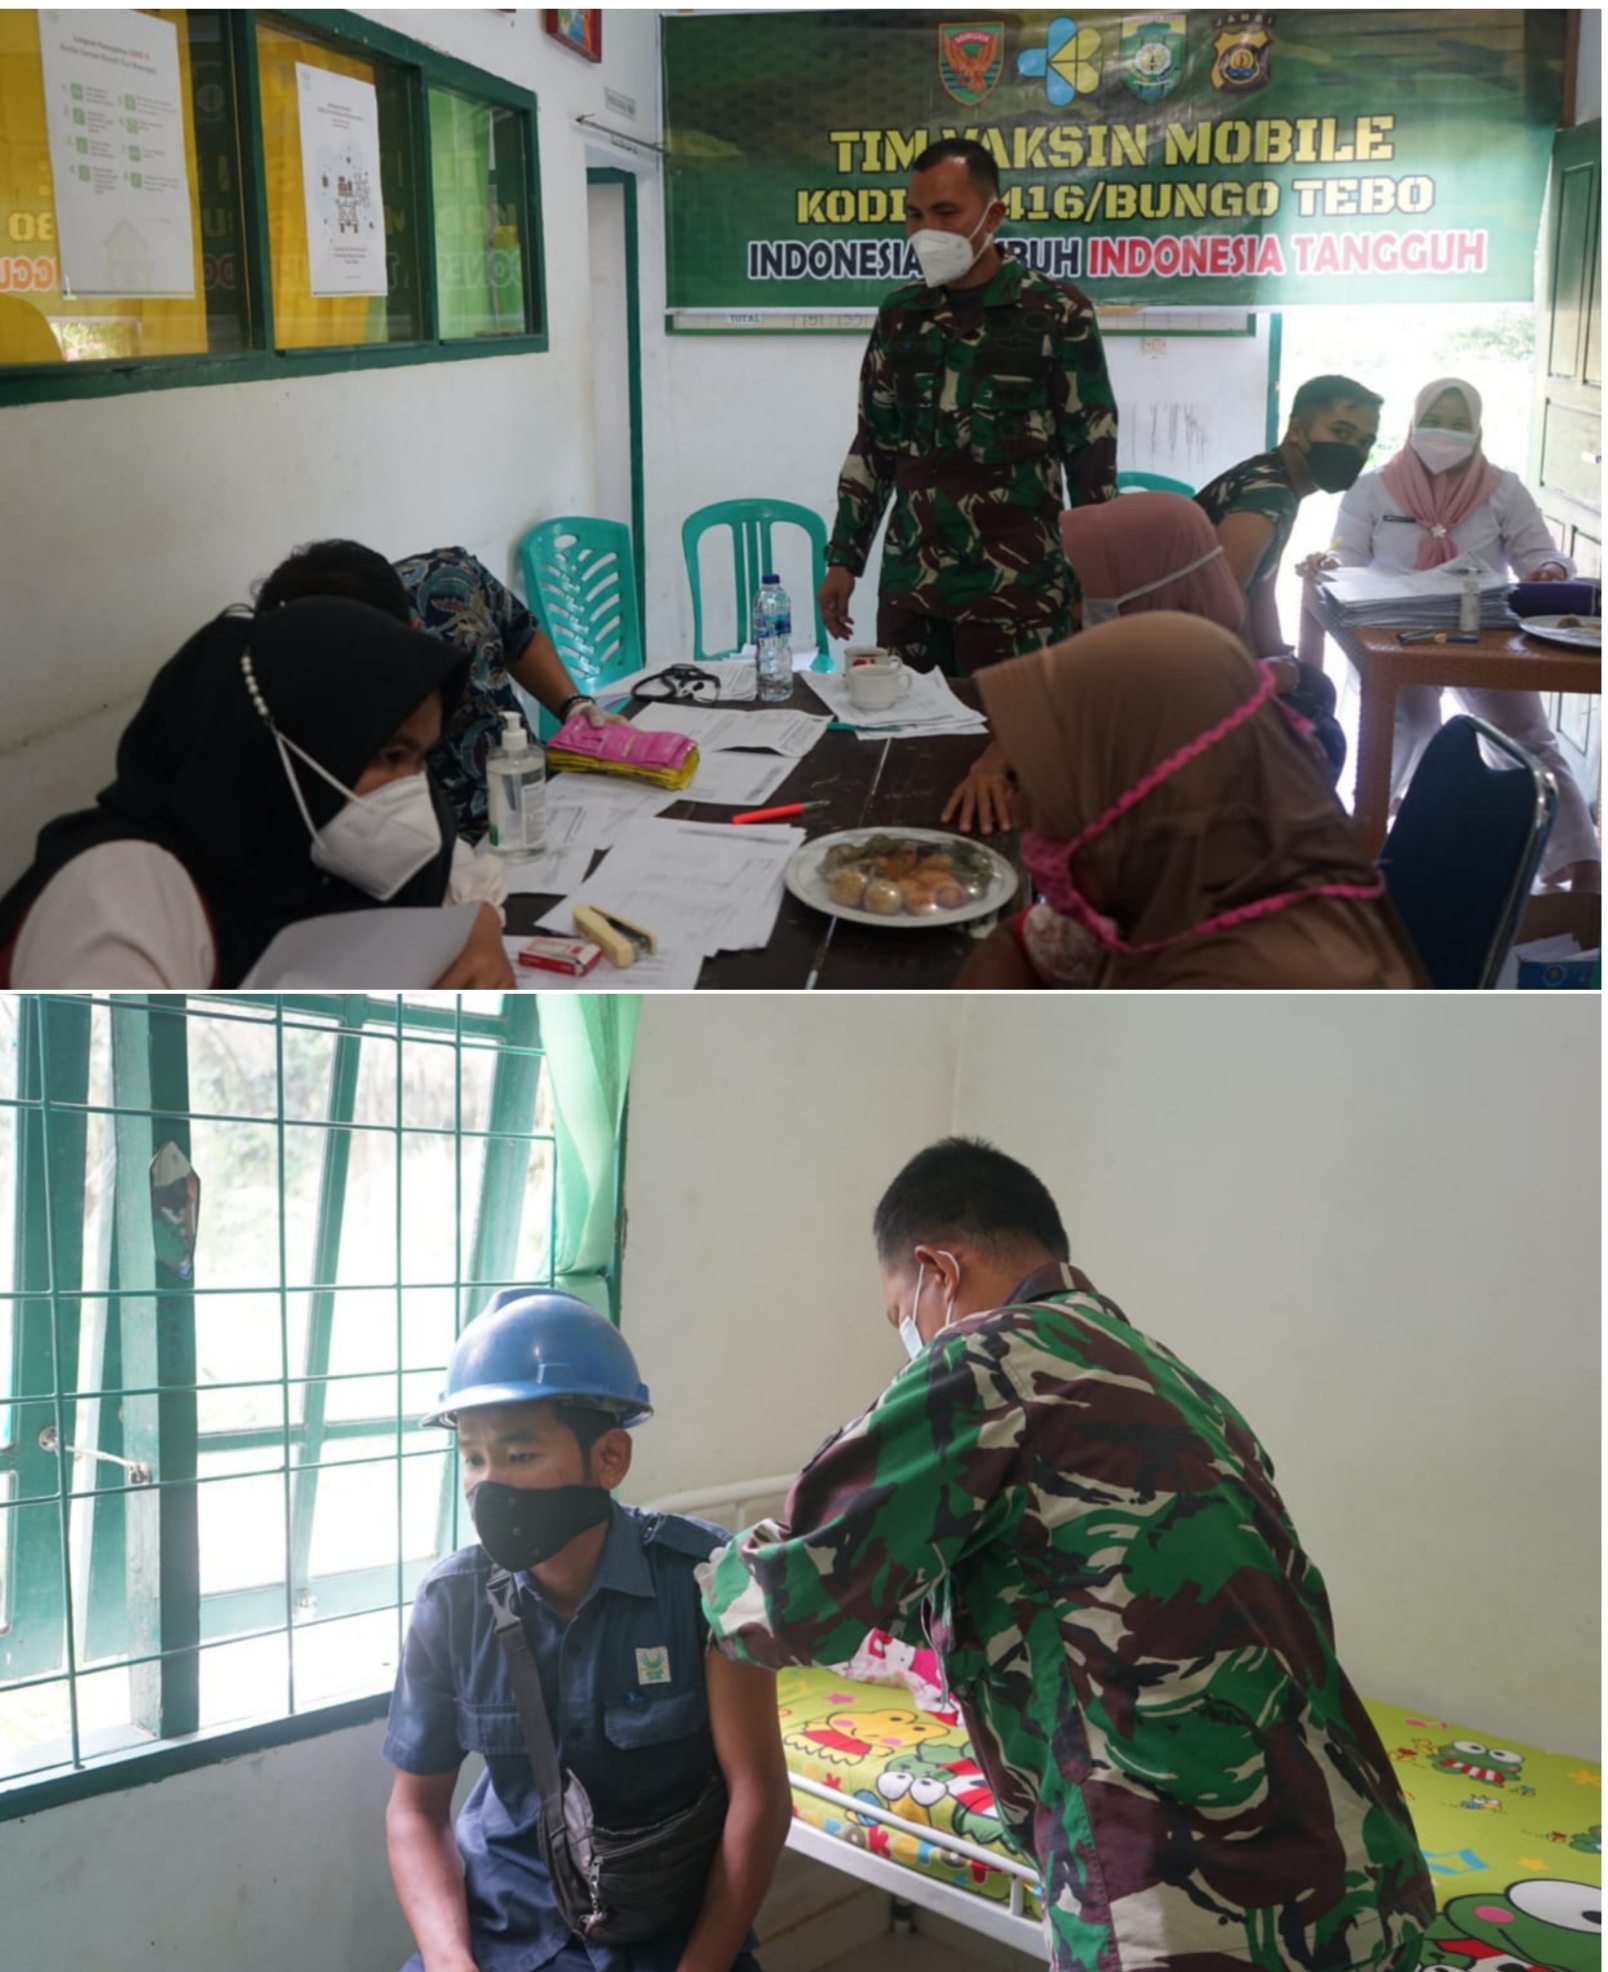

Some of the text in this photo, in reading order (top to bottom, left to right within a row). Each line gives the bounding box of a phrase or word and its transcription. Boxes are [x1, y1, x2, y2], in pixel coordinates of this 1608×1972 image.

[1214, 13, 1272, 26] JAMBI
[829, 128, 929, 173] TIM
[1164, 114, 1396, 167] MOBILE
[796, 188, 908, 224] KODI
[1292, 175, 1437, 218] TEBO
[748, 239, 926, 278] INDONESIA
[1087, 235, 1285, 277] INDONESIA
[1293, 230, 1488, 273] TANGGUH
